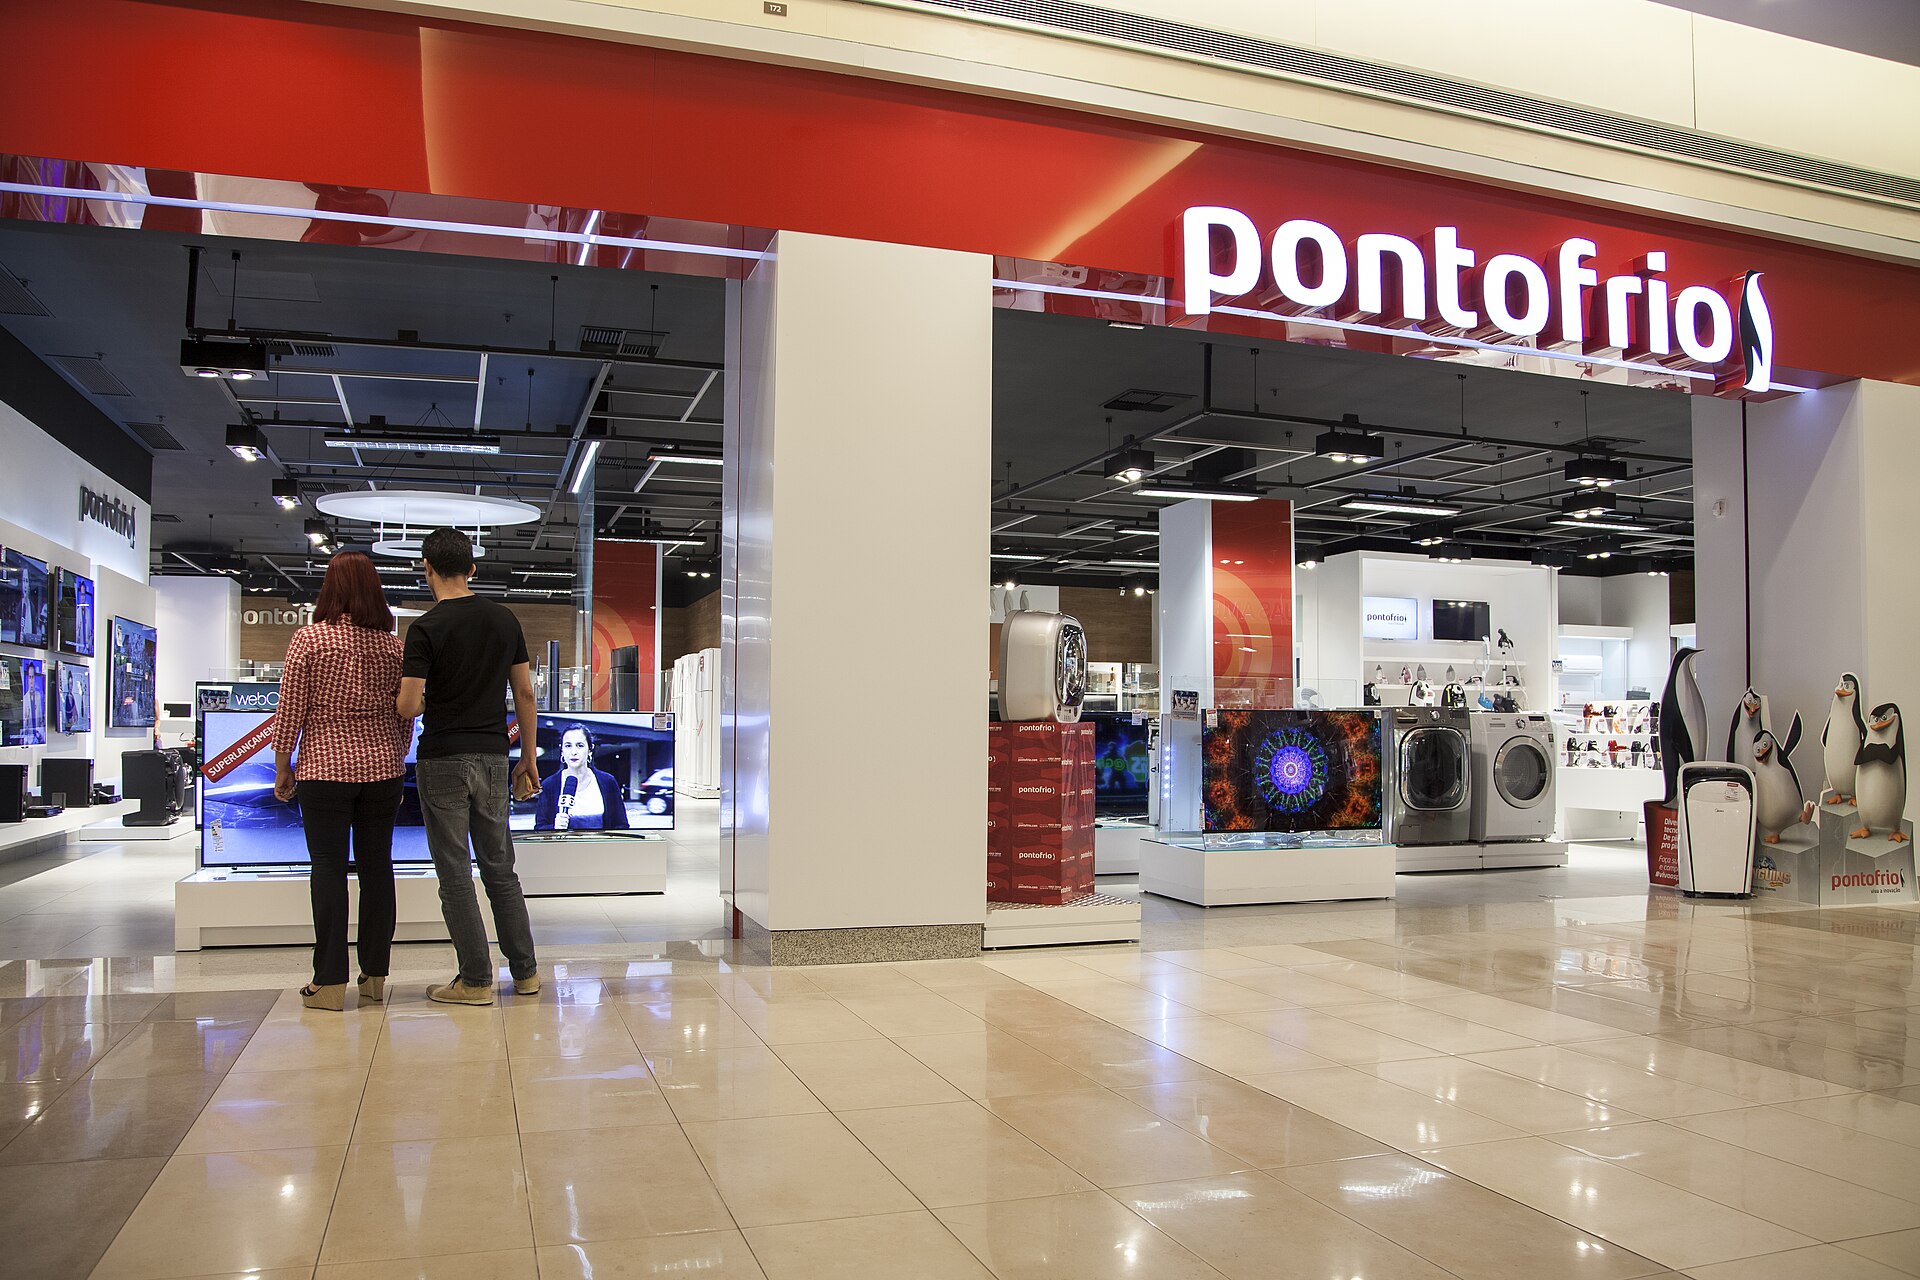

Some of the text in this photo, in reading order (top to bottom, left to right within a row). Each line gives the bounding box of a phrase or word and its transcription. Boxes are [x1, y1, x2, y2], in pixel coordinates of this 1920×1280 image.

[770, 4, 781, 13] 172
[1184, 206, 1732, 364] pontofrio
[79, 486, 131, 539] pontofrio
[1367, 613, 1405, 622] pontofrio
[235, 691, 280, 706] webO
[1019, 724, 1052, 733] pontofrio
[207, 722, 276, 777] SUPERLANÇAMEN
[1018, 786, 1052, 794] pontofrio
[1664, 818, 1678, 826] Dive
[1663, 833, 1671, 841] De
[1018, 852, 1053, 860] pontofrio
[1655, 871, 1679, 881] #vivaosp
[1755, 867, 1791, 884] GUINS
[1832, 869, 1899, 891] pontofrio
